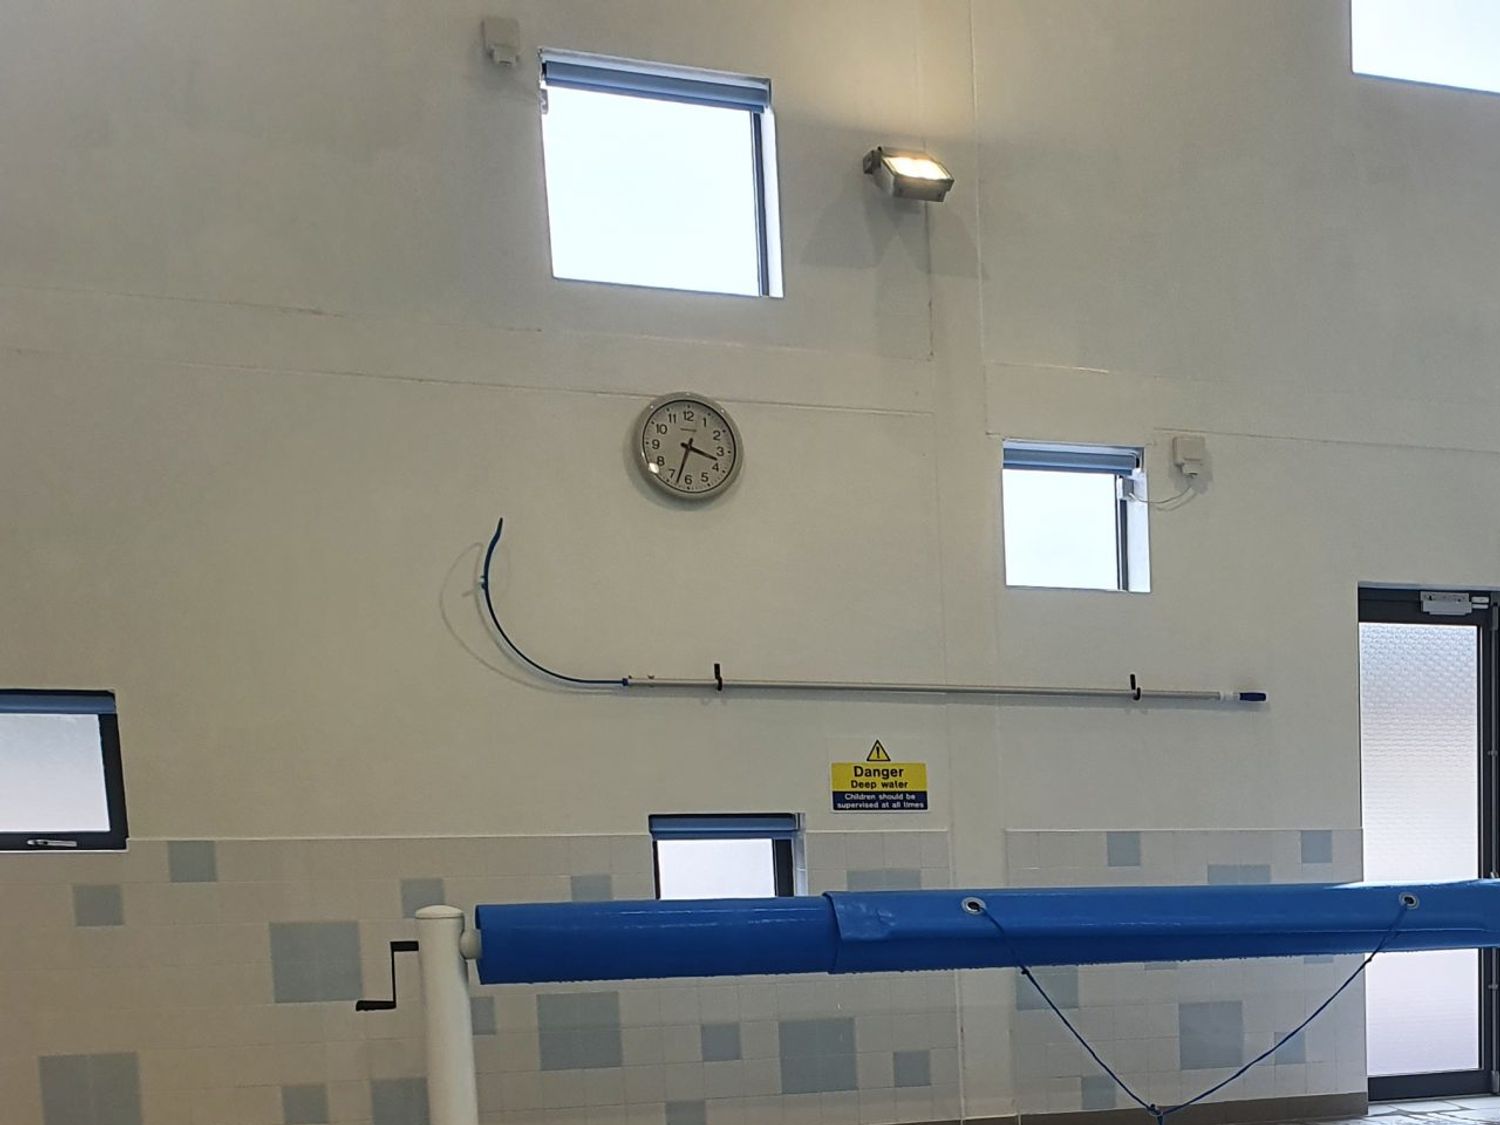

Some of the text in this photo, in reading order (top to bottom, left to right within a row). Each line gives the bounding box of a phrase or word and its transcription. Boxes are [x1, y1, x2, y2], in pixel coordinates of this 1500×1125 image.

[668, 413, 677, 424] 11
[683, 411, 695, 422] 12
[702, 417, 707, 428] 1
[656, 424, 668, 435] 10
[713, 430, 721, 441] 2
[651, 439, 660, 450] 9
[716, 447, 725, 457] 3
[657, 456, 665, 466] 8
[711, 462, 720, 472] 4
[668, 468, 676, 479] 7
[701, 472, 709, 482] 5
[684, 474, 693, 485] 6
[854, 766, 904, 779] Danger
[851, 780, 908, 789] Deep water
